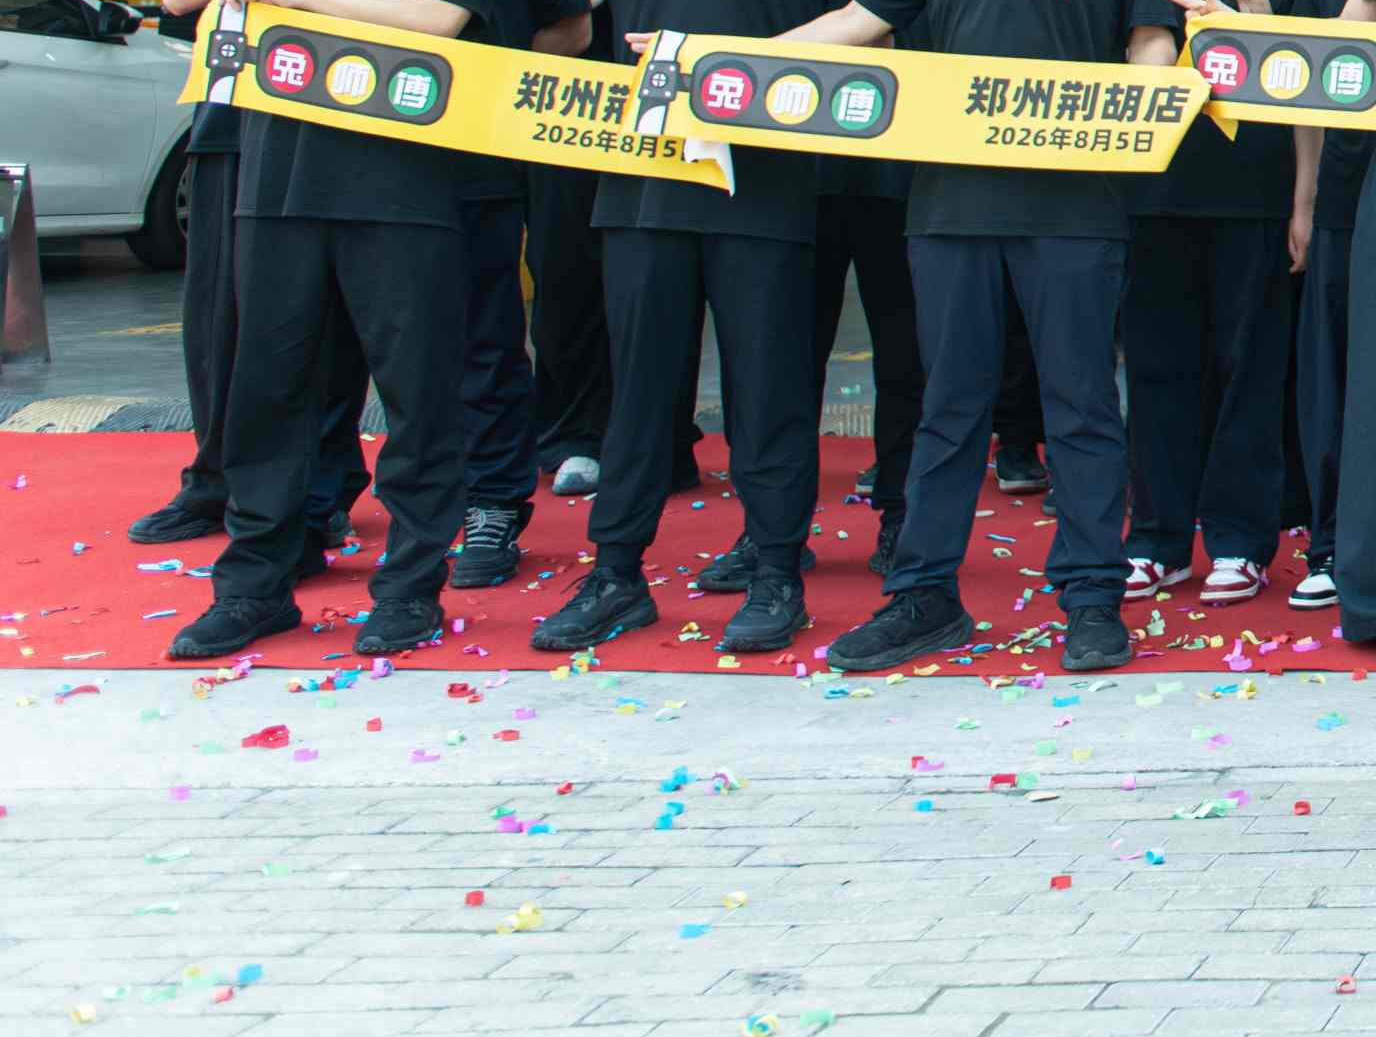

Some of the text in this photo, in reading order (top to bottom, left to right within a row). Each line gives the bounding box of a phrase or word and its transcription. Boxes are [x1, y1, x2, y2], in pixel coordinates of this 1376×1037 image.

[965, 76, 1190, 124] 郑州荆胡店
[532, 123, 686, 162] 2026年8月5
[985, 125, 1154, 154] 2026年8月5日
